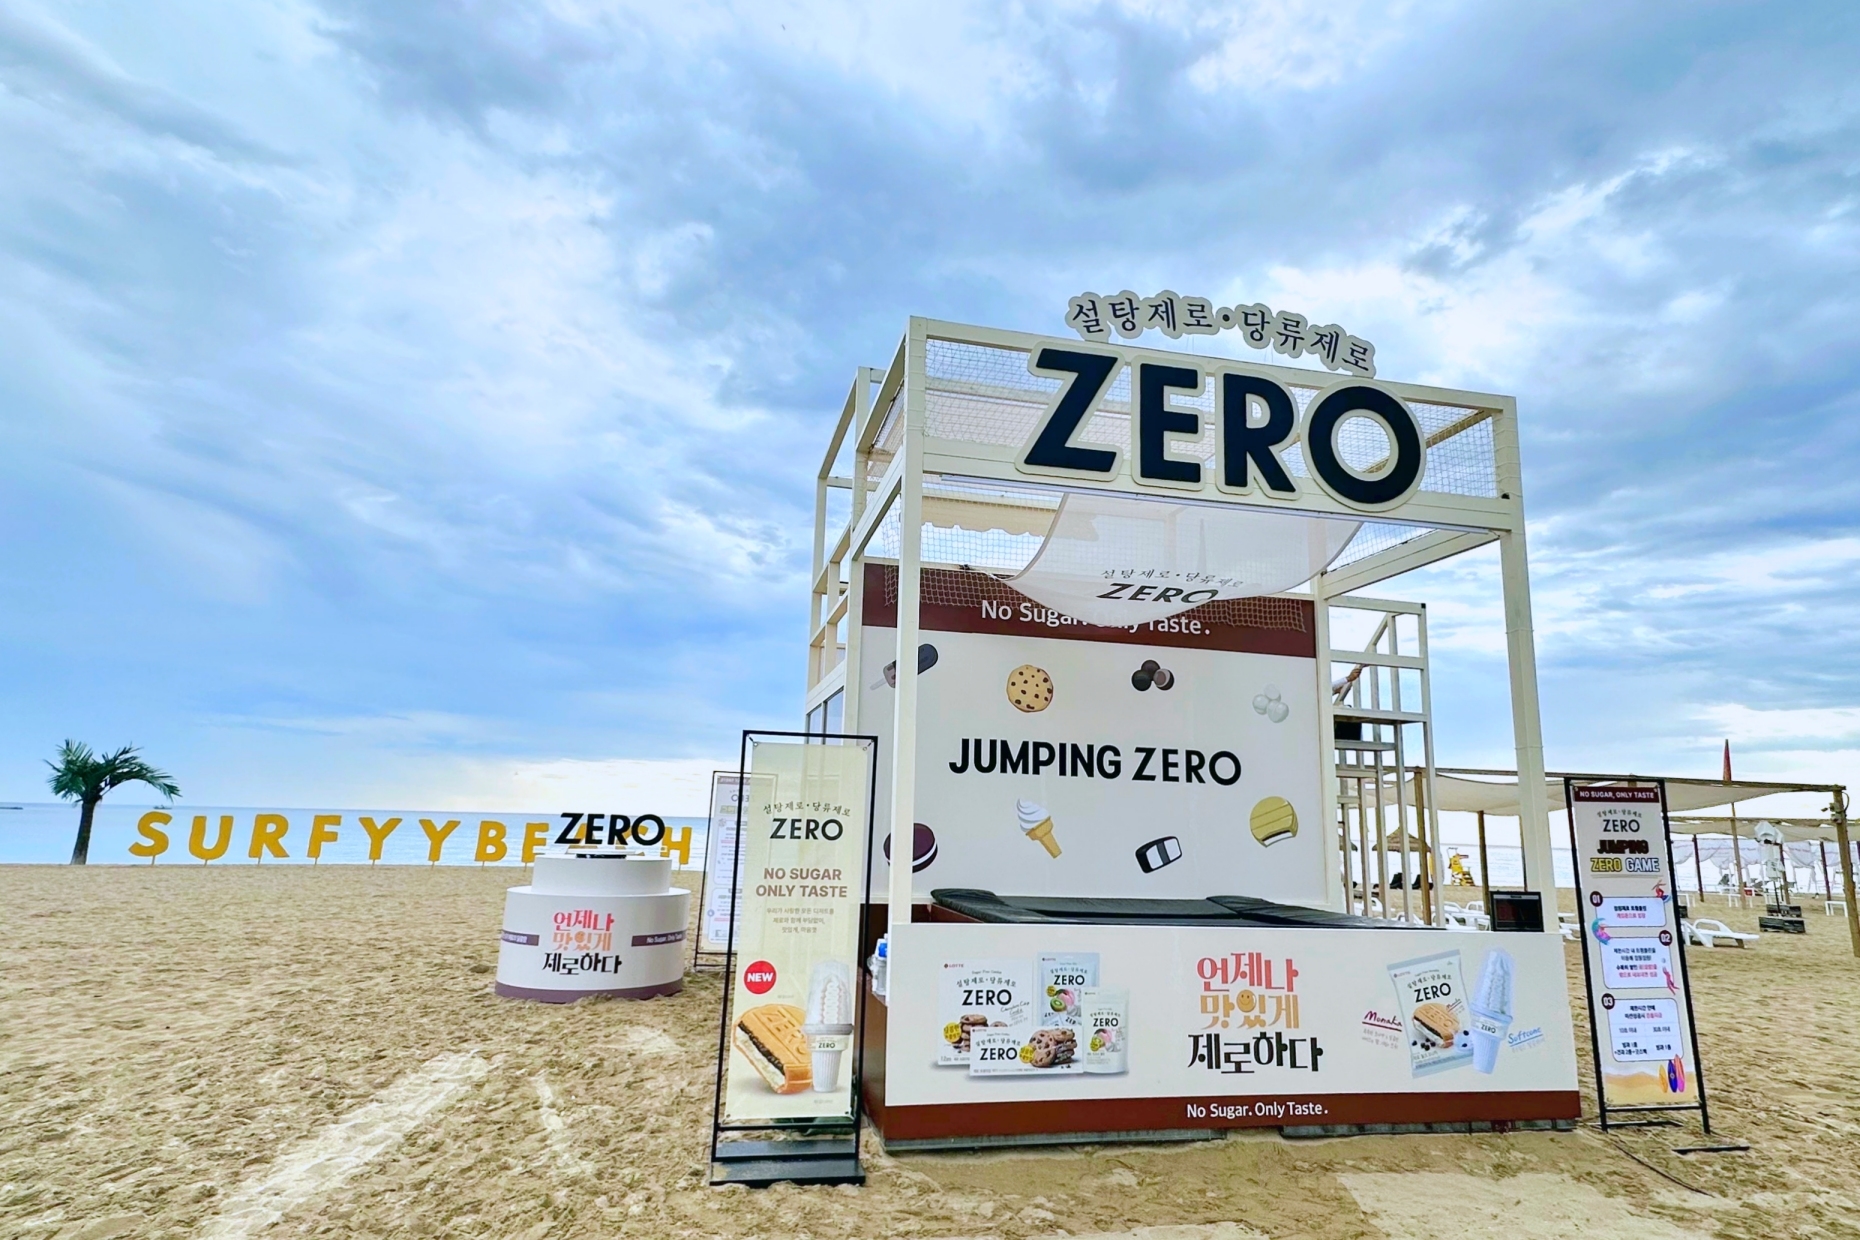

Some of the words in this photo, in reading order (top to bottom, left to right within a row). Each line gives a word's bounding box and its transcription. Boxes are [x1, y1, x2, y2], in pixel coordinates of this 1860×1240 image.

[1071, 297, 1371, 373] 설탕제로·당류제로
[1024, 347, 1422, 504] ZERO
[1095, 582, 1219, 604] ZERO
[981, 600, 1012, 620] No
[948, 738, 1122, 780] JUMPING
[1131, 746, 1243, 787] ZERO
[763, 801, 851, 817] 설탕제로·당류제로
[554, 812, 666, 846] ZERO
[769, 818, 844, 841] ZERO
[1602, 819, 1640, 833] ZERO
[1597, 839, 1649, 855] JUMPING
[1590, 857, 1622, 872] ZERO
[1625, 857, 1660, 873] GAME
[763, 868, 786, 880] NO
[789, 868, 842, 881] SUGAR
[755, 885, 796, 897] ONLY
[800, 885, 848, 898] TASTE
[1592, 895, 1601, 903] 01
[553, 909, 615, 932] 언제나
[553, 930, 613, 951] 맛있게
[1661, 934, 1671, 942] 02
[542, 952, 623, 975] 제로하다
[1197, 952, 1299, 992] 언제나
[747, 972, 774, 982] NEW
[1053, 974, 1085, 986] ZERO
[962, 989, 1012, 1006] ZERO
[1413, 982, 1452, 1003] ZERO
[1200, 989, 1300, 1030] 맛있게
[1602, 997, 1613, 1006] 03
[1093, 1017, 1119, 1027] ZERO
[1364, 1010, 1403, 1027] Monaka
[1481, 1023, 1497, 1034] ZERO
[980, 1047, 1018, 1061] ZERO
[1187, 1031, 1324, 1074] 제로하다
[1186, 1104, 1206, 1118] No
[1209, 1103, 1252, 1119] Sugar.
[1254, 1101, 1286, 1118] Only
[1286, 1101, 1328, 1115] Taste.
